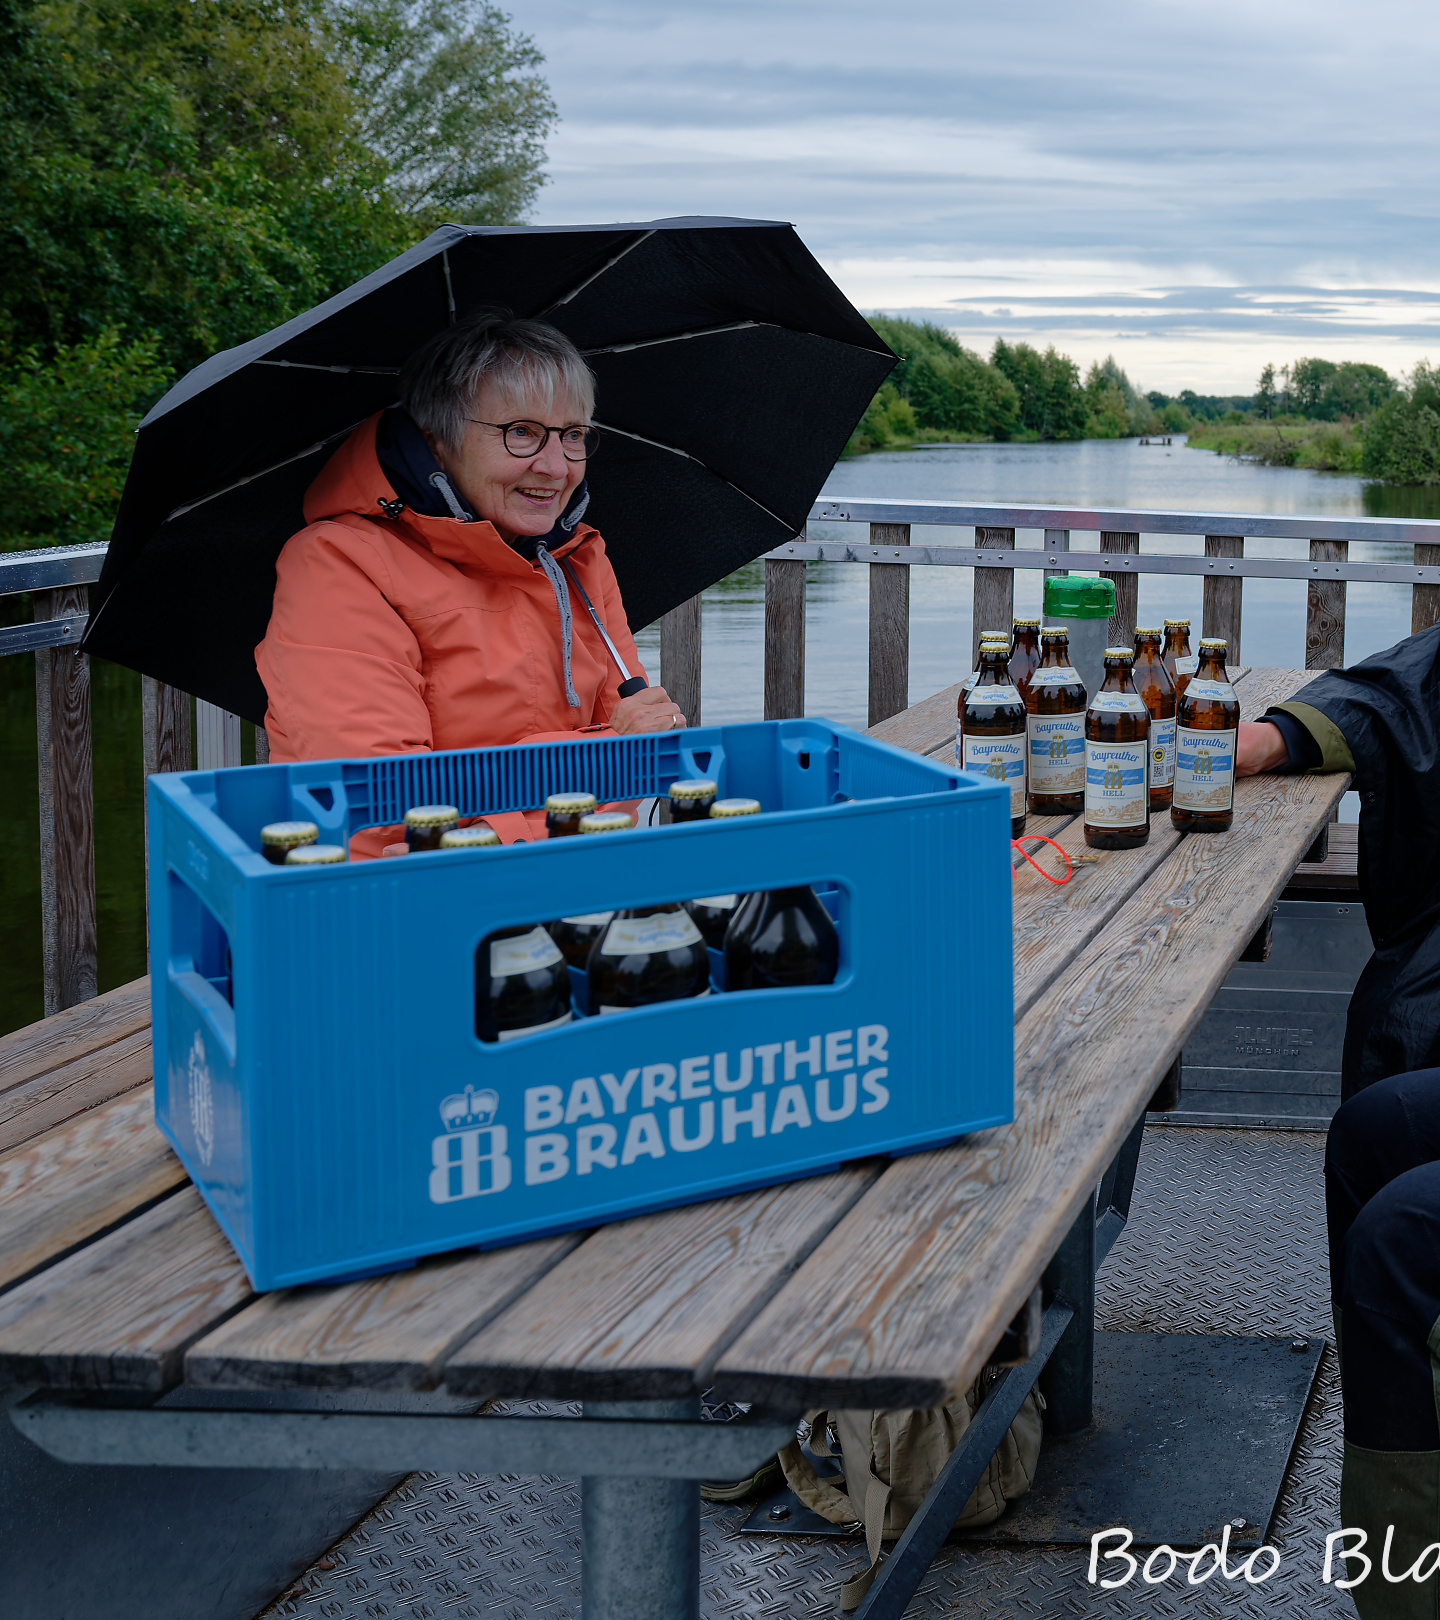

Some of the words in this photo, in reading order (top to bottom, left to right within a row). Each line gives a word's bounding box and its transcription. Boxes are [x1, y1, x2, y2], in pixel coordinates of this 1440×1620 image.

[1034, 722, 1082, 734] Bayreuther
[970, 743, 1021, 756] Bayreuther
[1181, 736, 1229, 750] Bayreuther
[1048, 758, 1071, 766] HELL
[1090, 750, 1140, 763] Bayreuther
[1191, 774, 1214, 782] HELL
[1102, 789, 1126, 797] HELL
[524, 1023, 890, 1132] BAYREUTHER
[524, 1066, 890, 1186] BRAUHAUS
